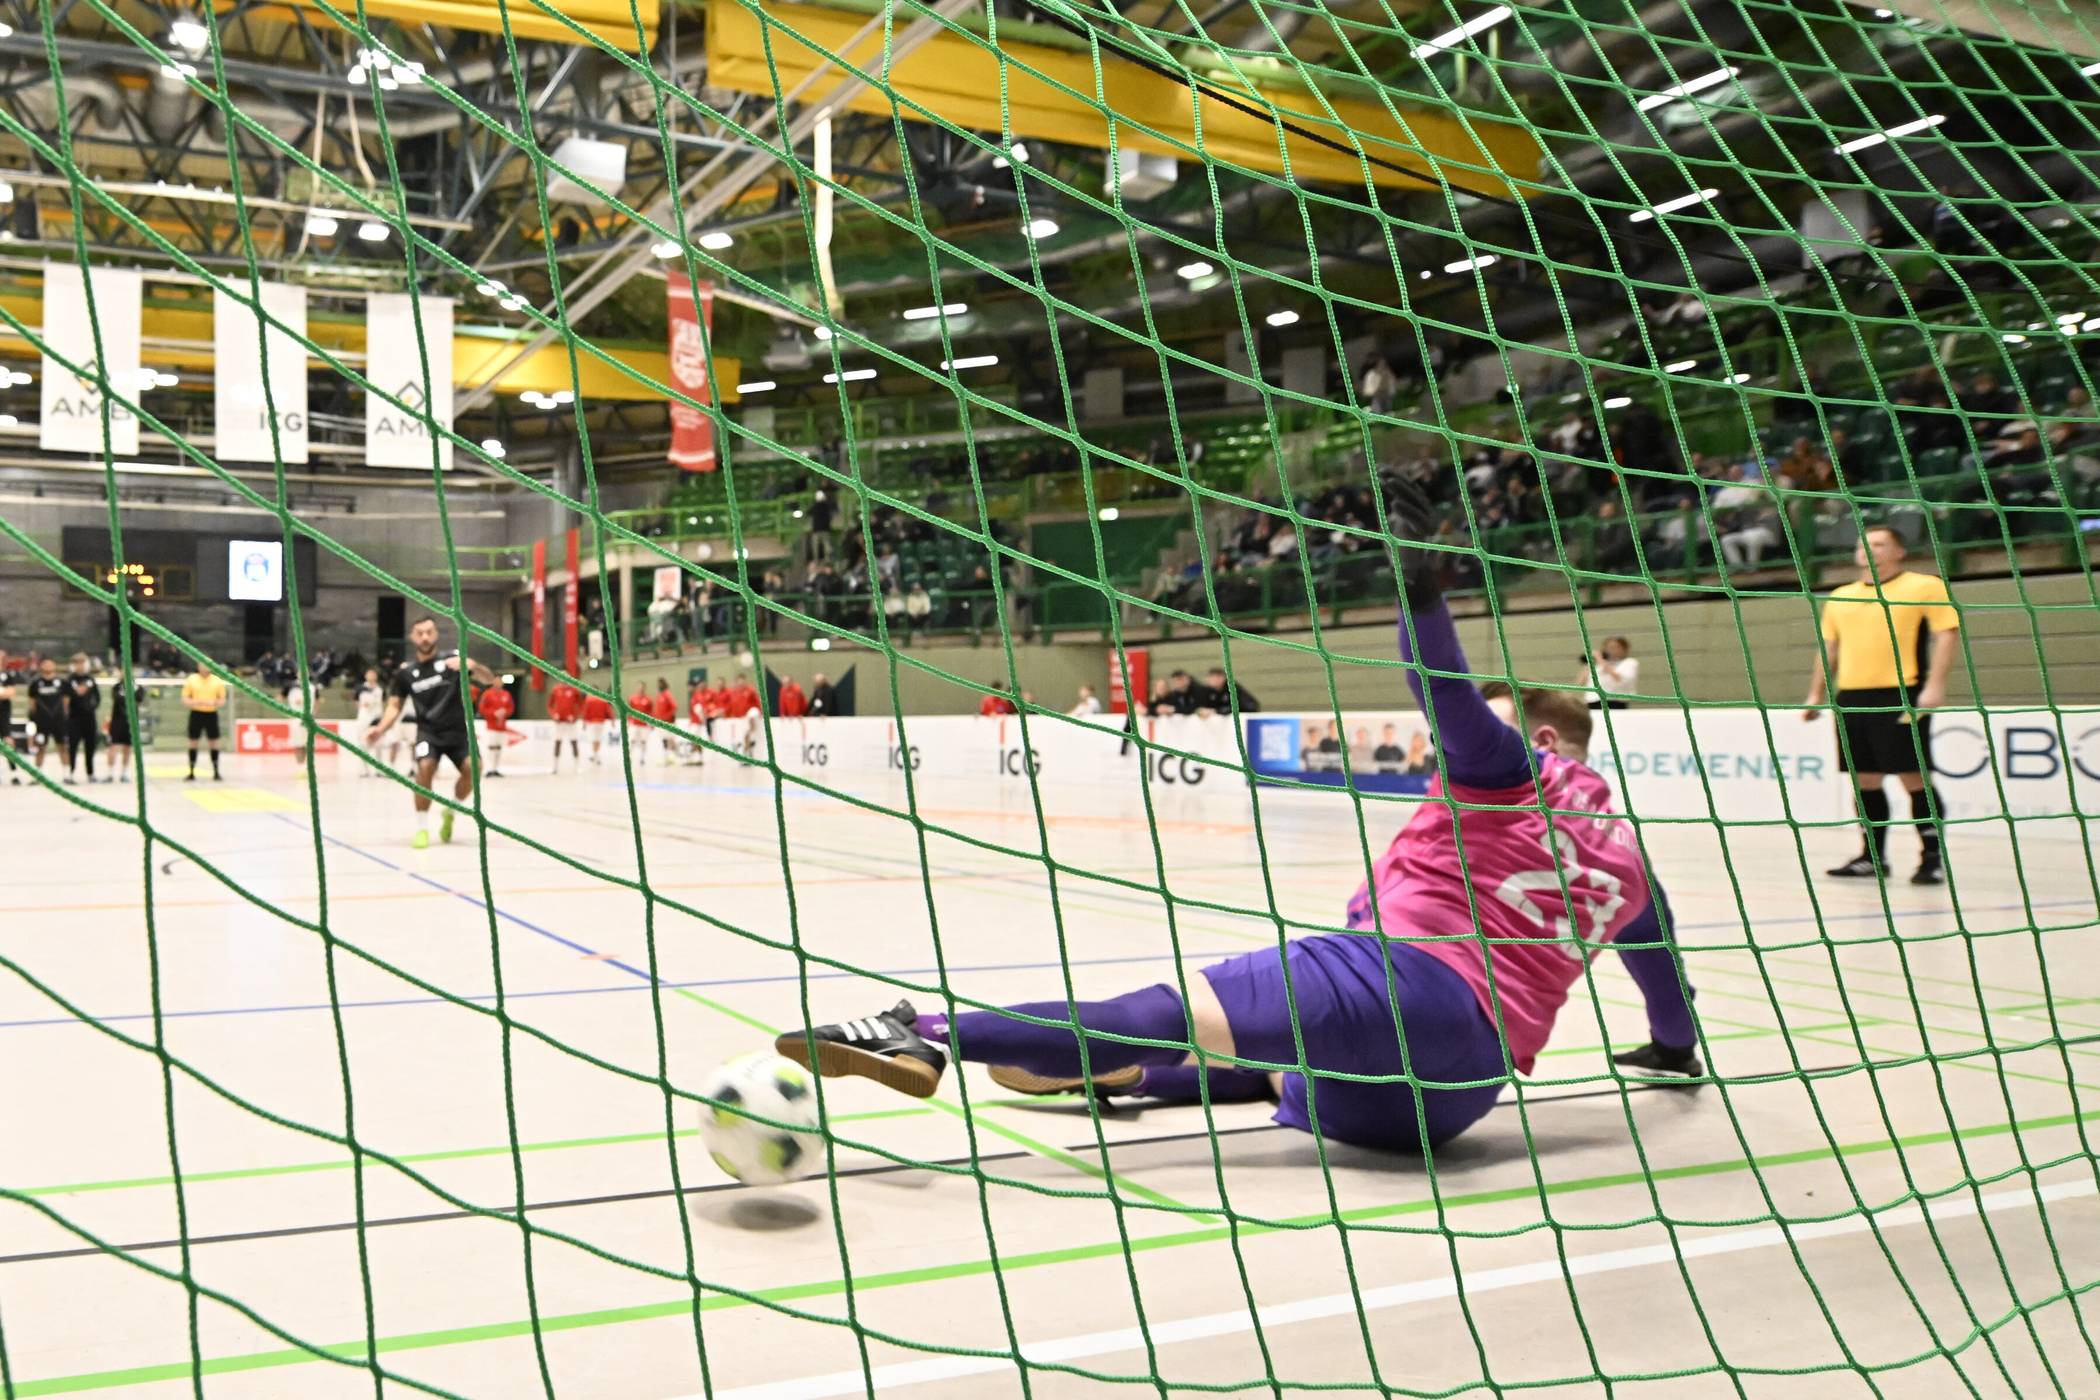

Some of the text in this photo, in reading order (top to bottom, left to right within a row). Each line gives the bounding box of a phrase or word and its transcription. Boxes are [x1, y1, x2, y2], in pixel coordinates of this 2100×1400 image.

[374, 415, 448, 439] AM
[802, 744, 829, 766] ICG
[888, 746, 921, 770] ICG
[1000, 749, 1041, 777] ICG
[1147, 751, 1206, 785] ICG
